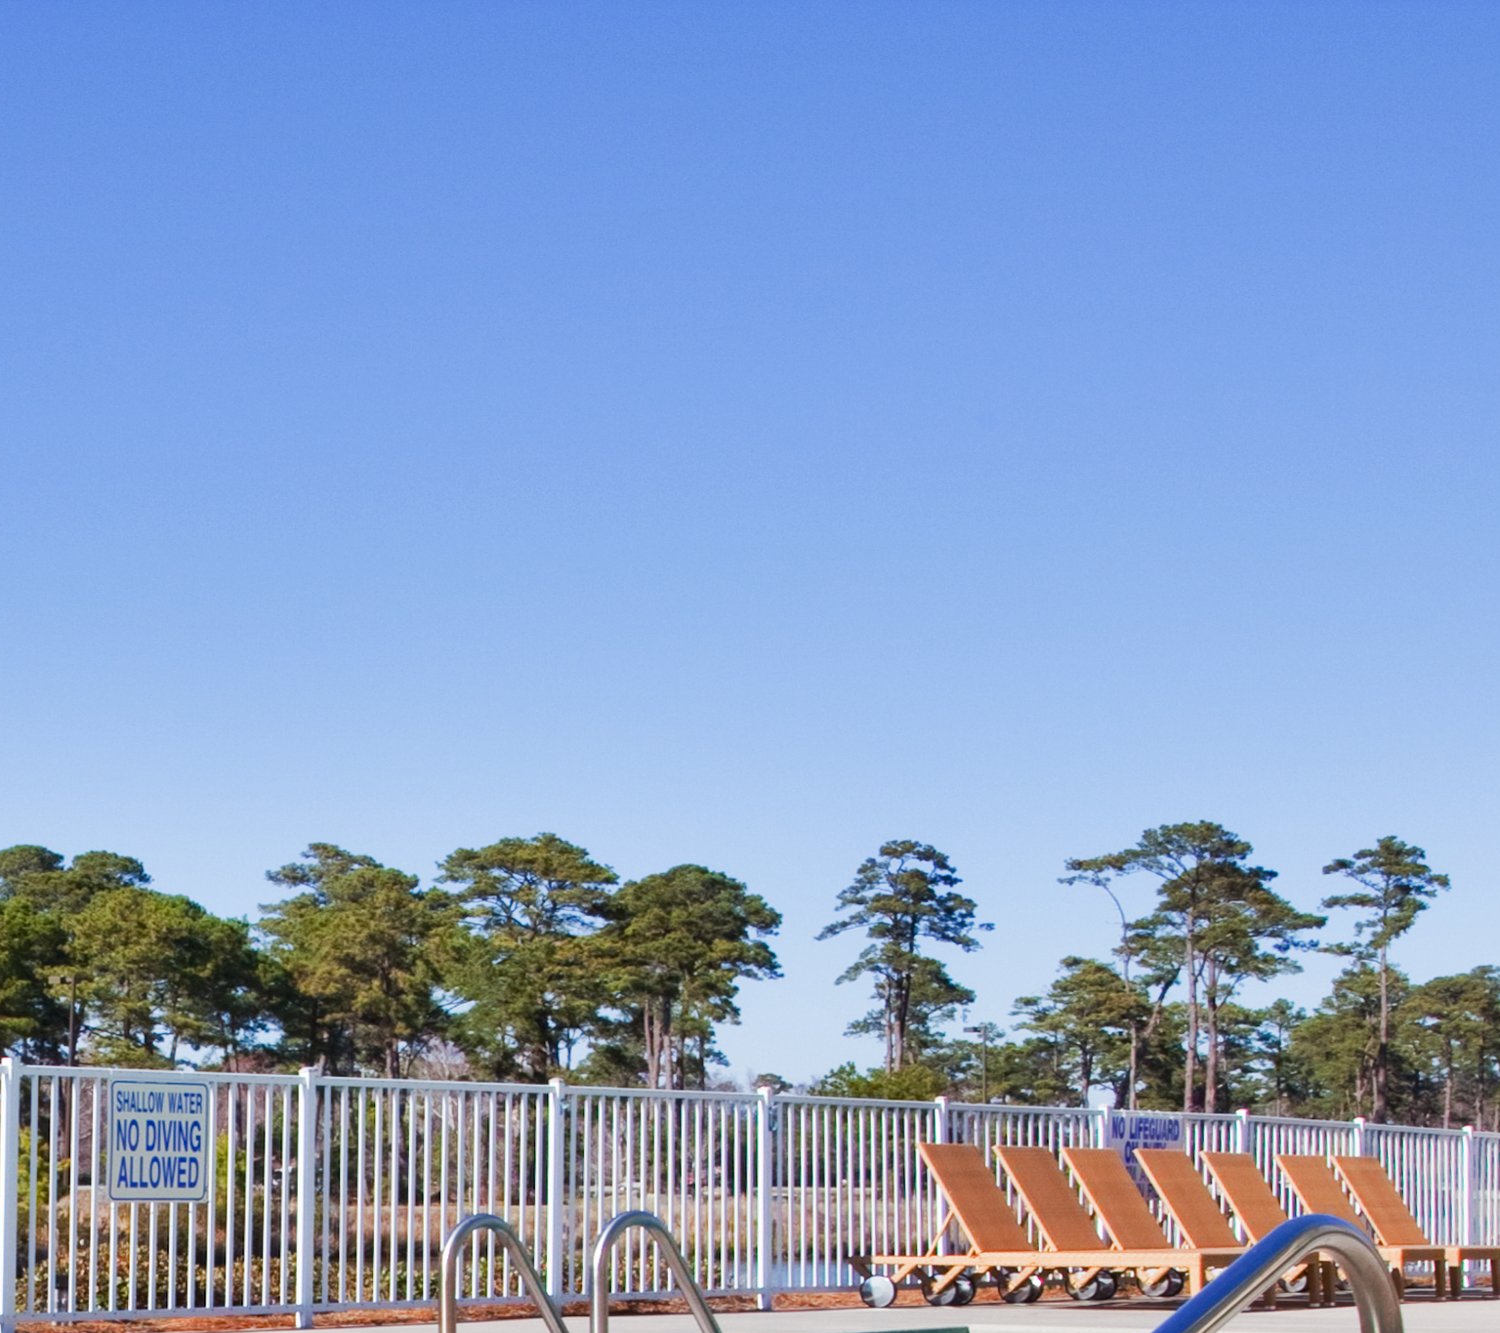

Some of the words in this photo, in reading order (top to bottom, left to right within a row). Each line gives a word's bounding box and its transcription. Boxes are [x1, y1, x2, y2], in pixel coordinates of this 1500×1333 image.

[116, 1091, 164, 1113] SHALLOW
[168, 1092, 202, 1114] WATER
[116, 1119, 139, 1151] NO
[145, 1119, 201, 1152] DIVING
[1112, 1116, 1126, 1139] NO
[1129, 1117, 1179, 1141] LIFEGUARD
[116, 1156, 199, 1188] ALLOWED
